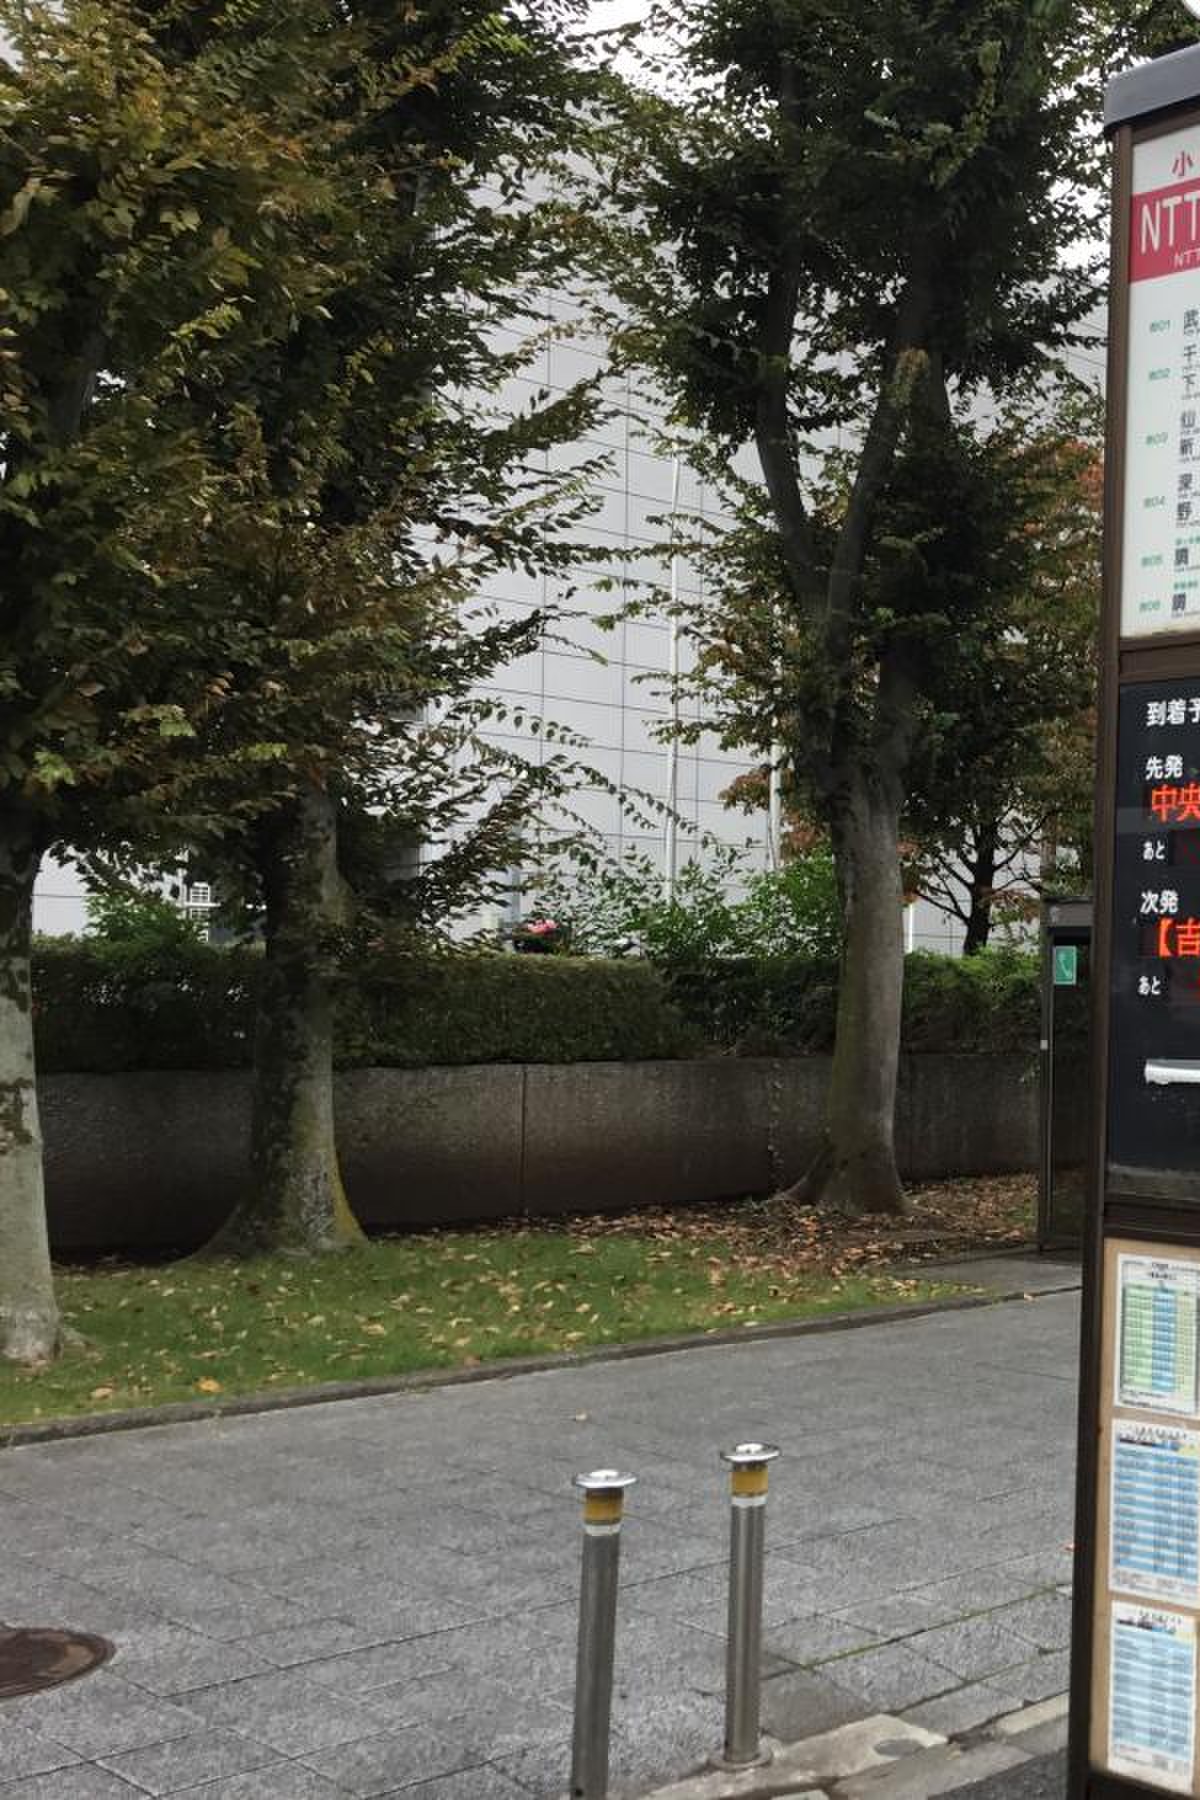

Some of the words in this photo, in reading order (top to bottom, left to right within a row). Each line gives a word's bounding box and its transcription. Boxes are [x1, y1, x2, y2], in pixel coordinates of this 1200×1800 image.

[1174, 247, 1200, 267] NTT
[1145, 754, 1183, 780] 先発
[1143, 840, 1165, 861] あと
[1140, 890, 1179, 914] 次発
[1138, 976, 1161, 995] あと
